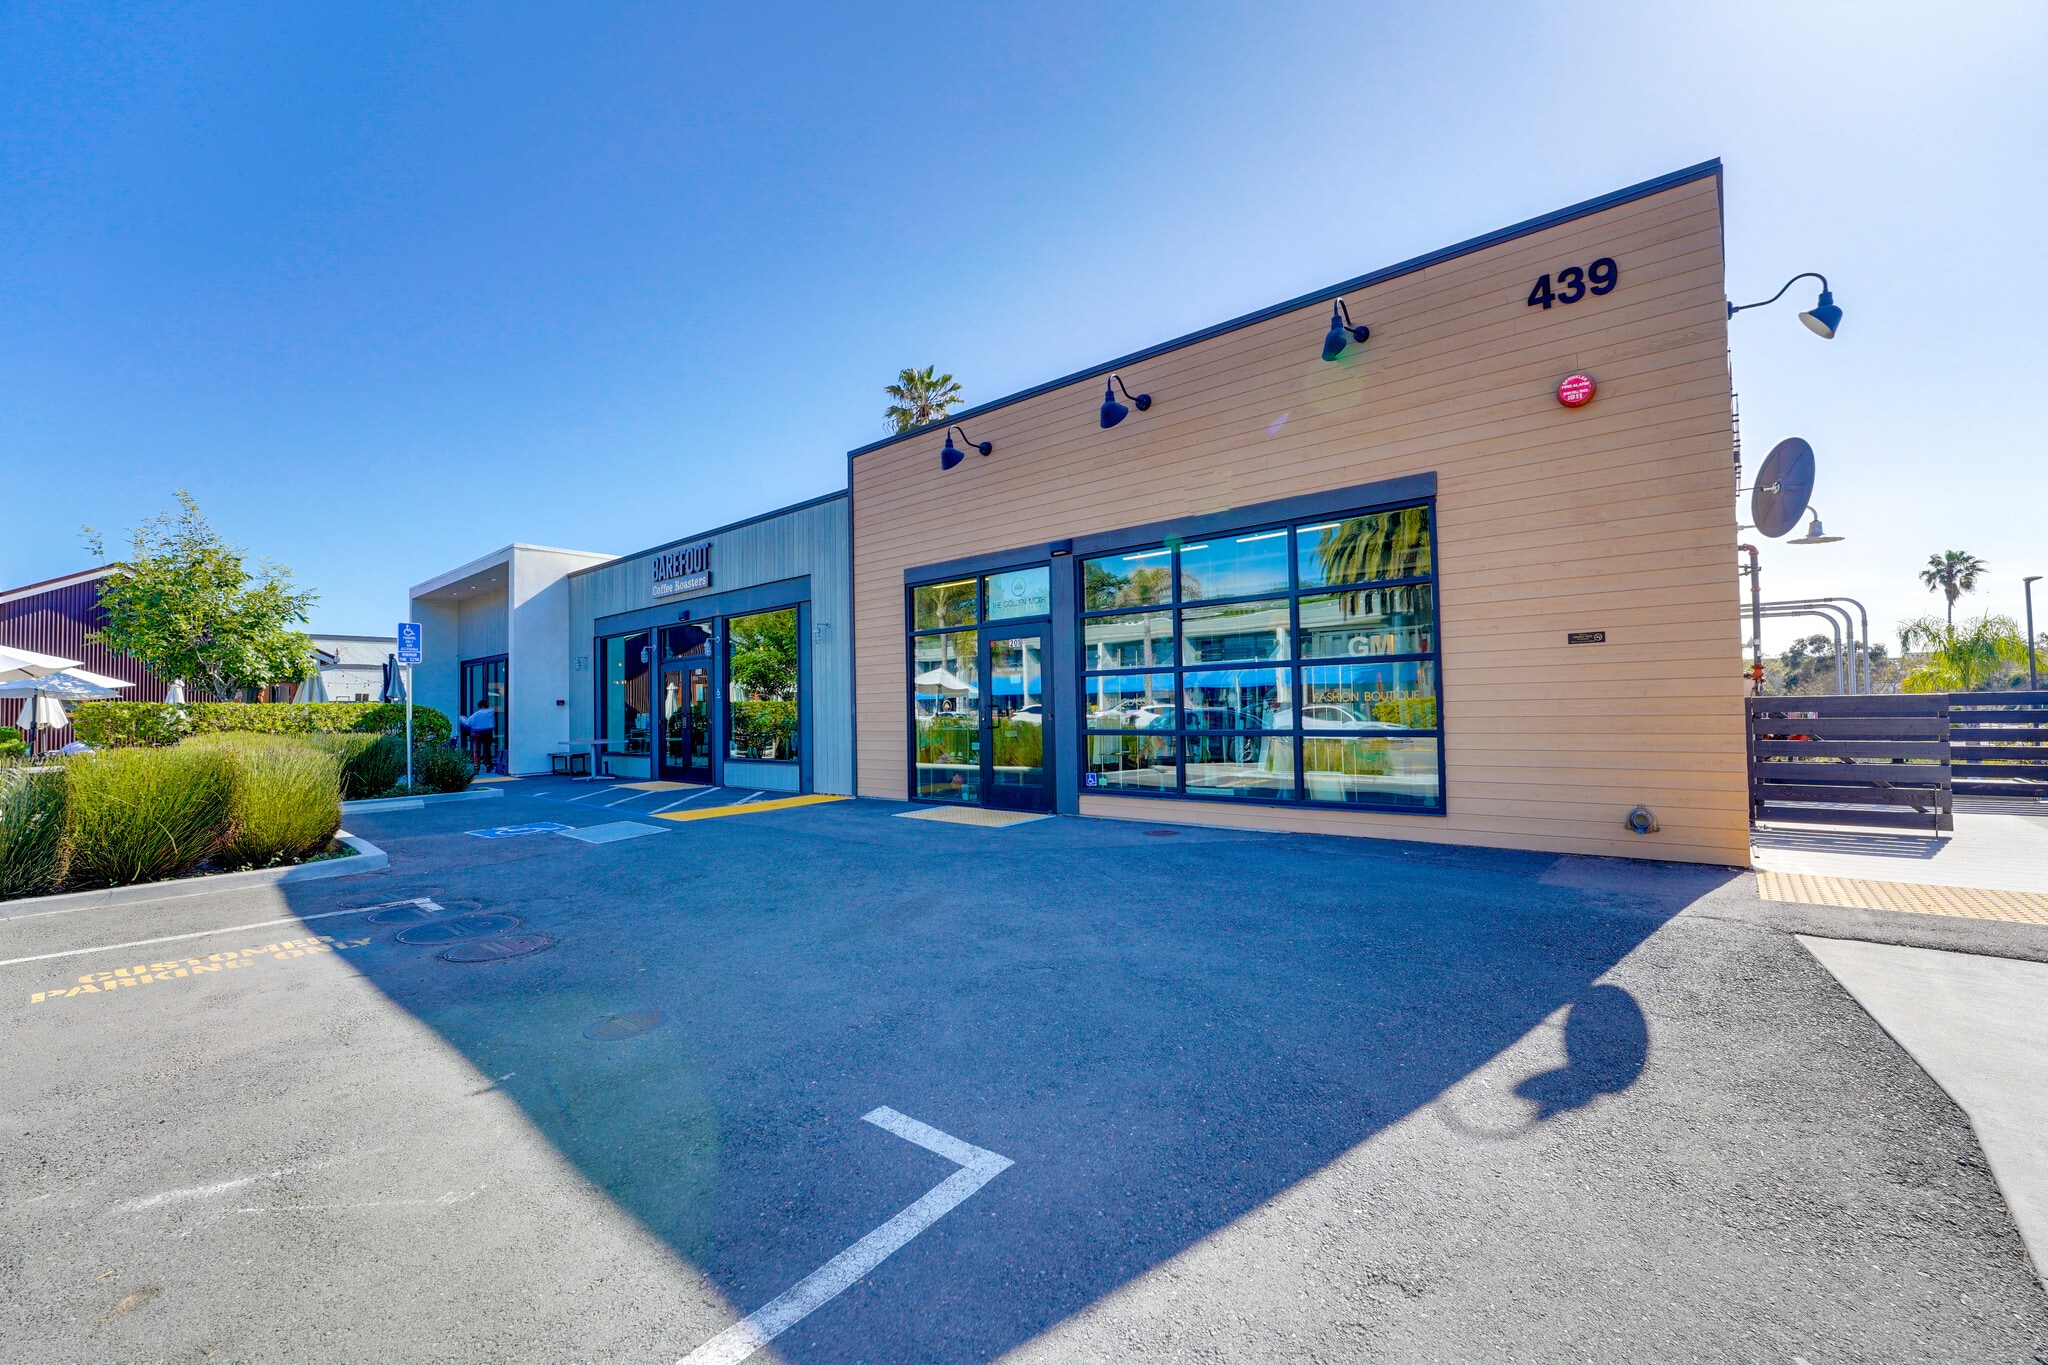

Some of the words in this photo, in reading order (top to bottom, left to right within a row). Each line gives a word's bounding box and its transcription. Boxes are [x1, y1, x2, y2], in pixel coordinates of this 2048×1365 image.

[1527, 257, 1618, 310] 439
[652, 543, 710, 582] BAREFOOT
[652, 583, 673, 596] Coffee
[675, 576, 707, 591] Roasters
[991, 601, 1002, 609] THE
[1348, 634, 1394, 657] GM
[1313, 692, 1359, 702] FASHION
[1364, 690, 1420, 701] BOUTIQUE
[31, 959, 256, 1004] PARKING
[274, 937, 371, 960] ONLY
[78, 935, 336, 983] CUSTOMER
